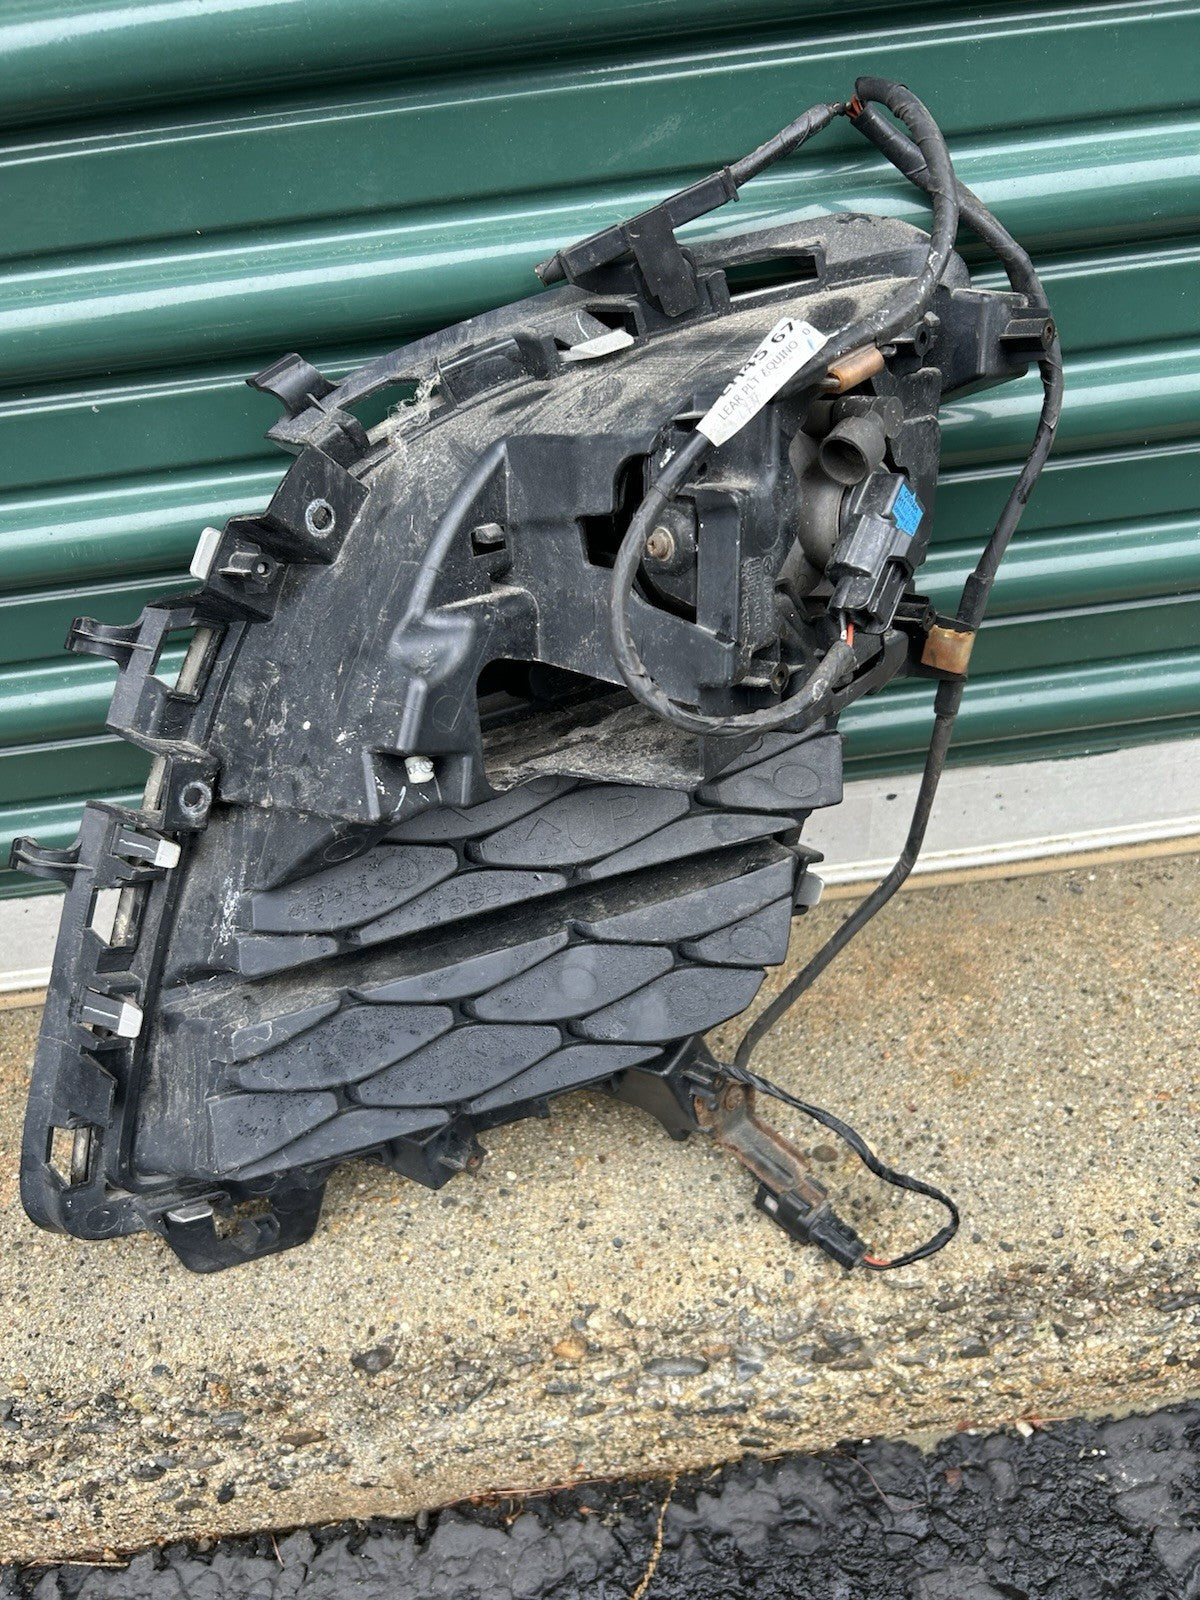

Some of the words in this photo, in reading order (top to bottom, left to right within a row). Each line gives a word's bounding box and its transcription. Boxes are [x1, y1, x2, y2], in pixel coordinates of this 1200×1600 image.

[771, 321, 794, 344] 67
[718, 395, 744, 420] LEAR
[741, 377, 760, 395] PLT
[567, 795, 640, 848] UP
